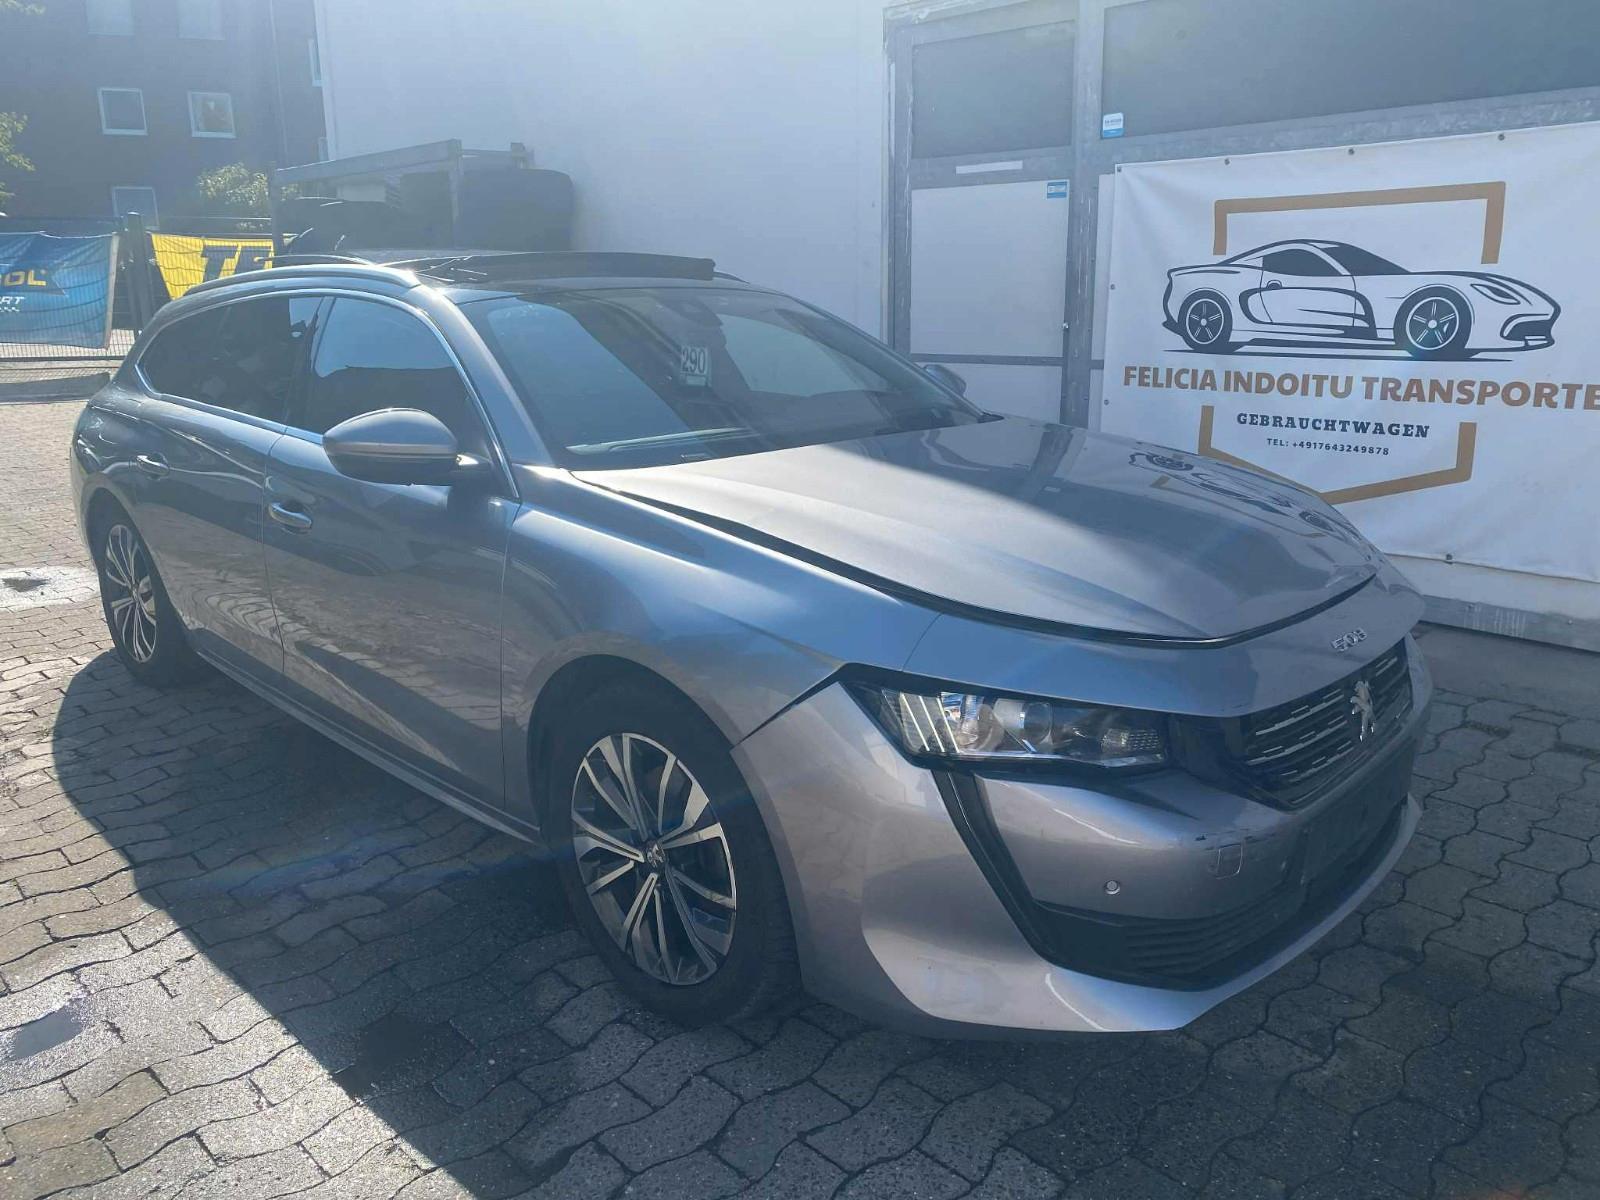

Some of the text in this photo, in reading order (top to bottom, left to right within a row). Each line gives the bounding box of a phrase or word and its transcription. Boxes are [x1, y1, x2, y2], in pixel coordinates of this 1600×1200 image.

[0, 270, 46, 287] OL
[0, 296, 25, 305] RT
[682, 347, 706, 374] 290
[1123, 366, 1600, 410] FELICIA INDOITU TRANSPORTE
[1237, 412, 1430, 438] GEBRAUCHTWAGEN
[1267, 438, 1389, 456] TEL: +4917643249878
[1331, 627, 1367, 651] 508
